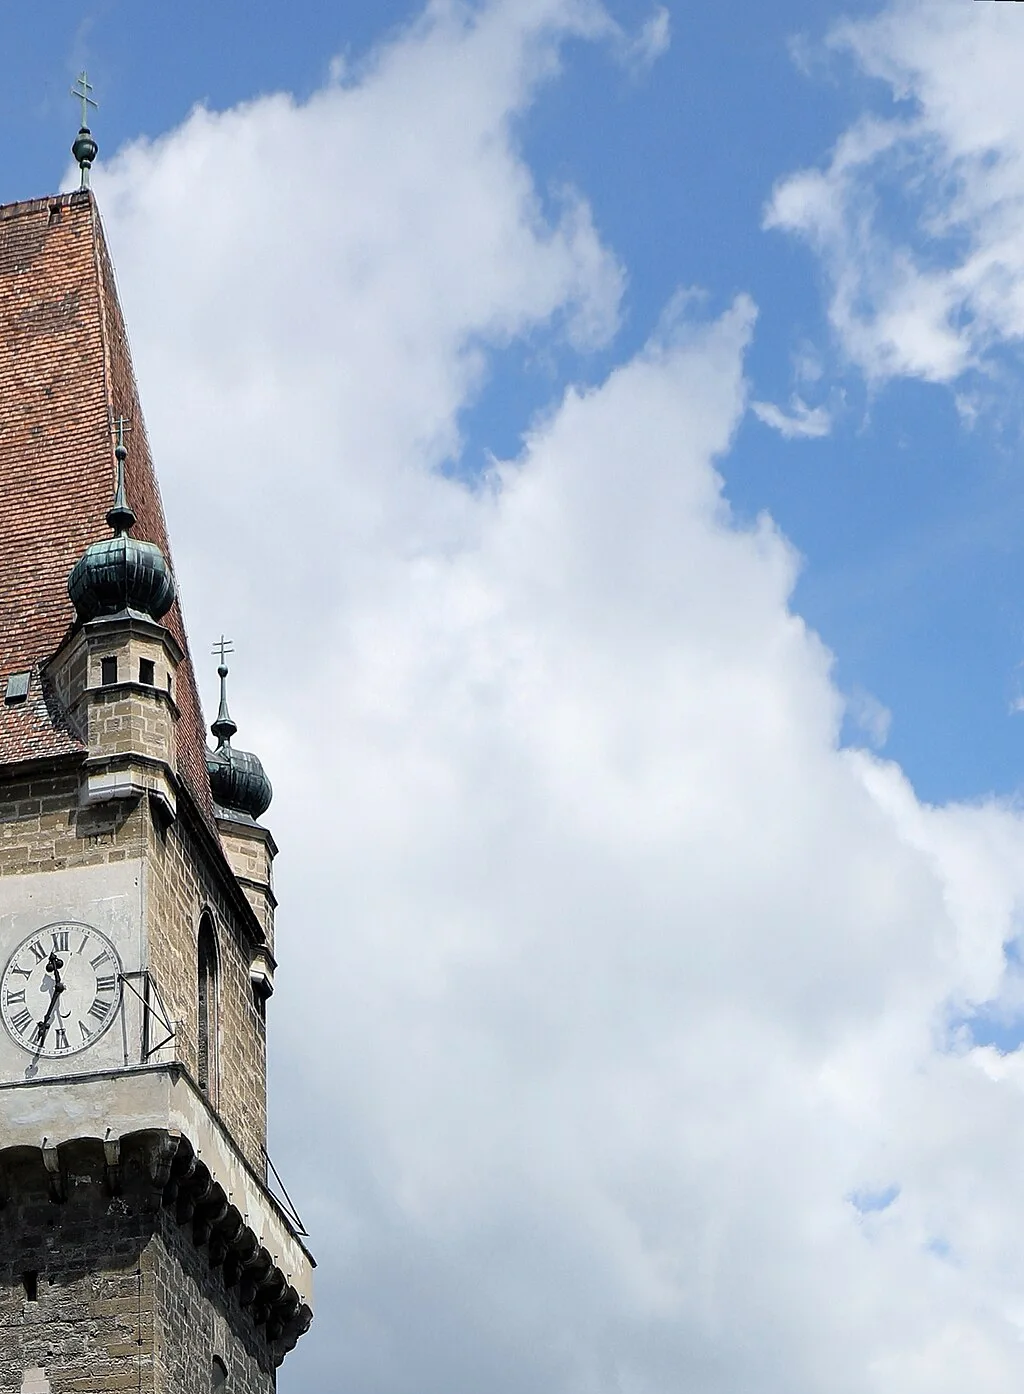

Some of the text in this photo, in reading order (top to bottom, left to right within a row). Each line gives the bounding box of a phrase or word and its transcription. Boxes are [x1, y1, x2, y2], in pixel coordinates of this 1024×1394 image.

[51, 932, 70, 952] XII
[76, 935, 89, 955] I
[28, 940, 48, 965] XI
[89, 949, 111, 970] II
[12, 963, 32, 981] X
[96, 975, 115, 993] III
[7, 989, 26, 1005] IX
[54, 1028, 71, 1050] VI
[78, 1020, 93, 1041] V
